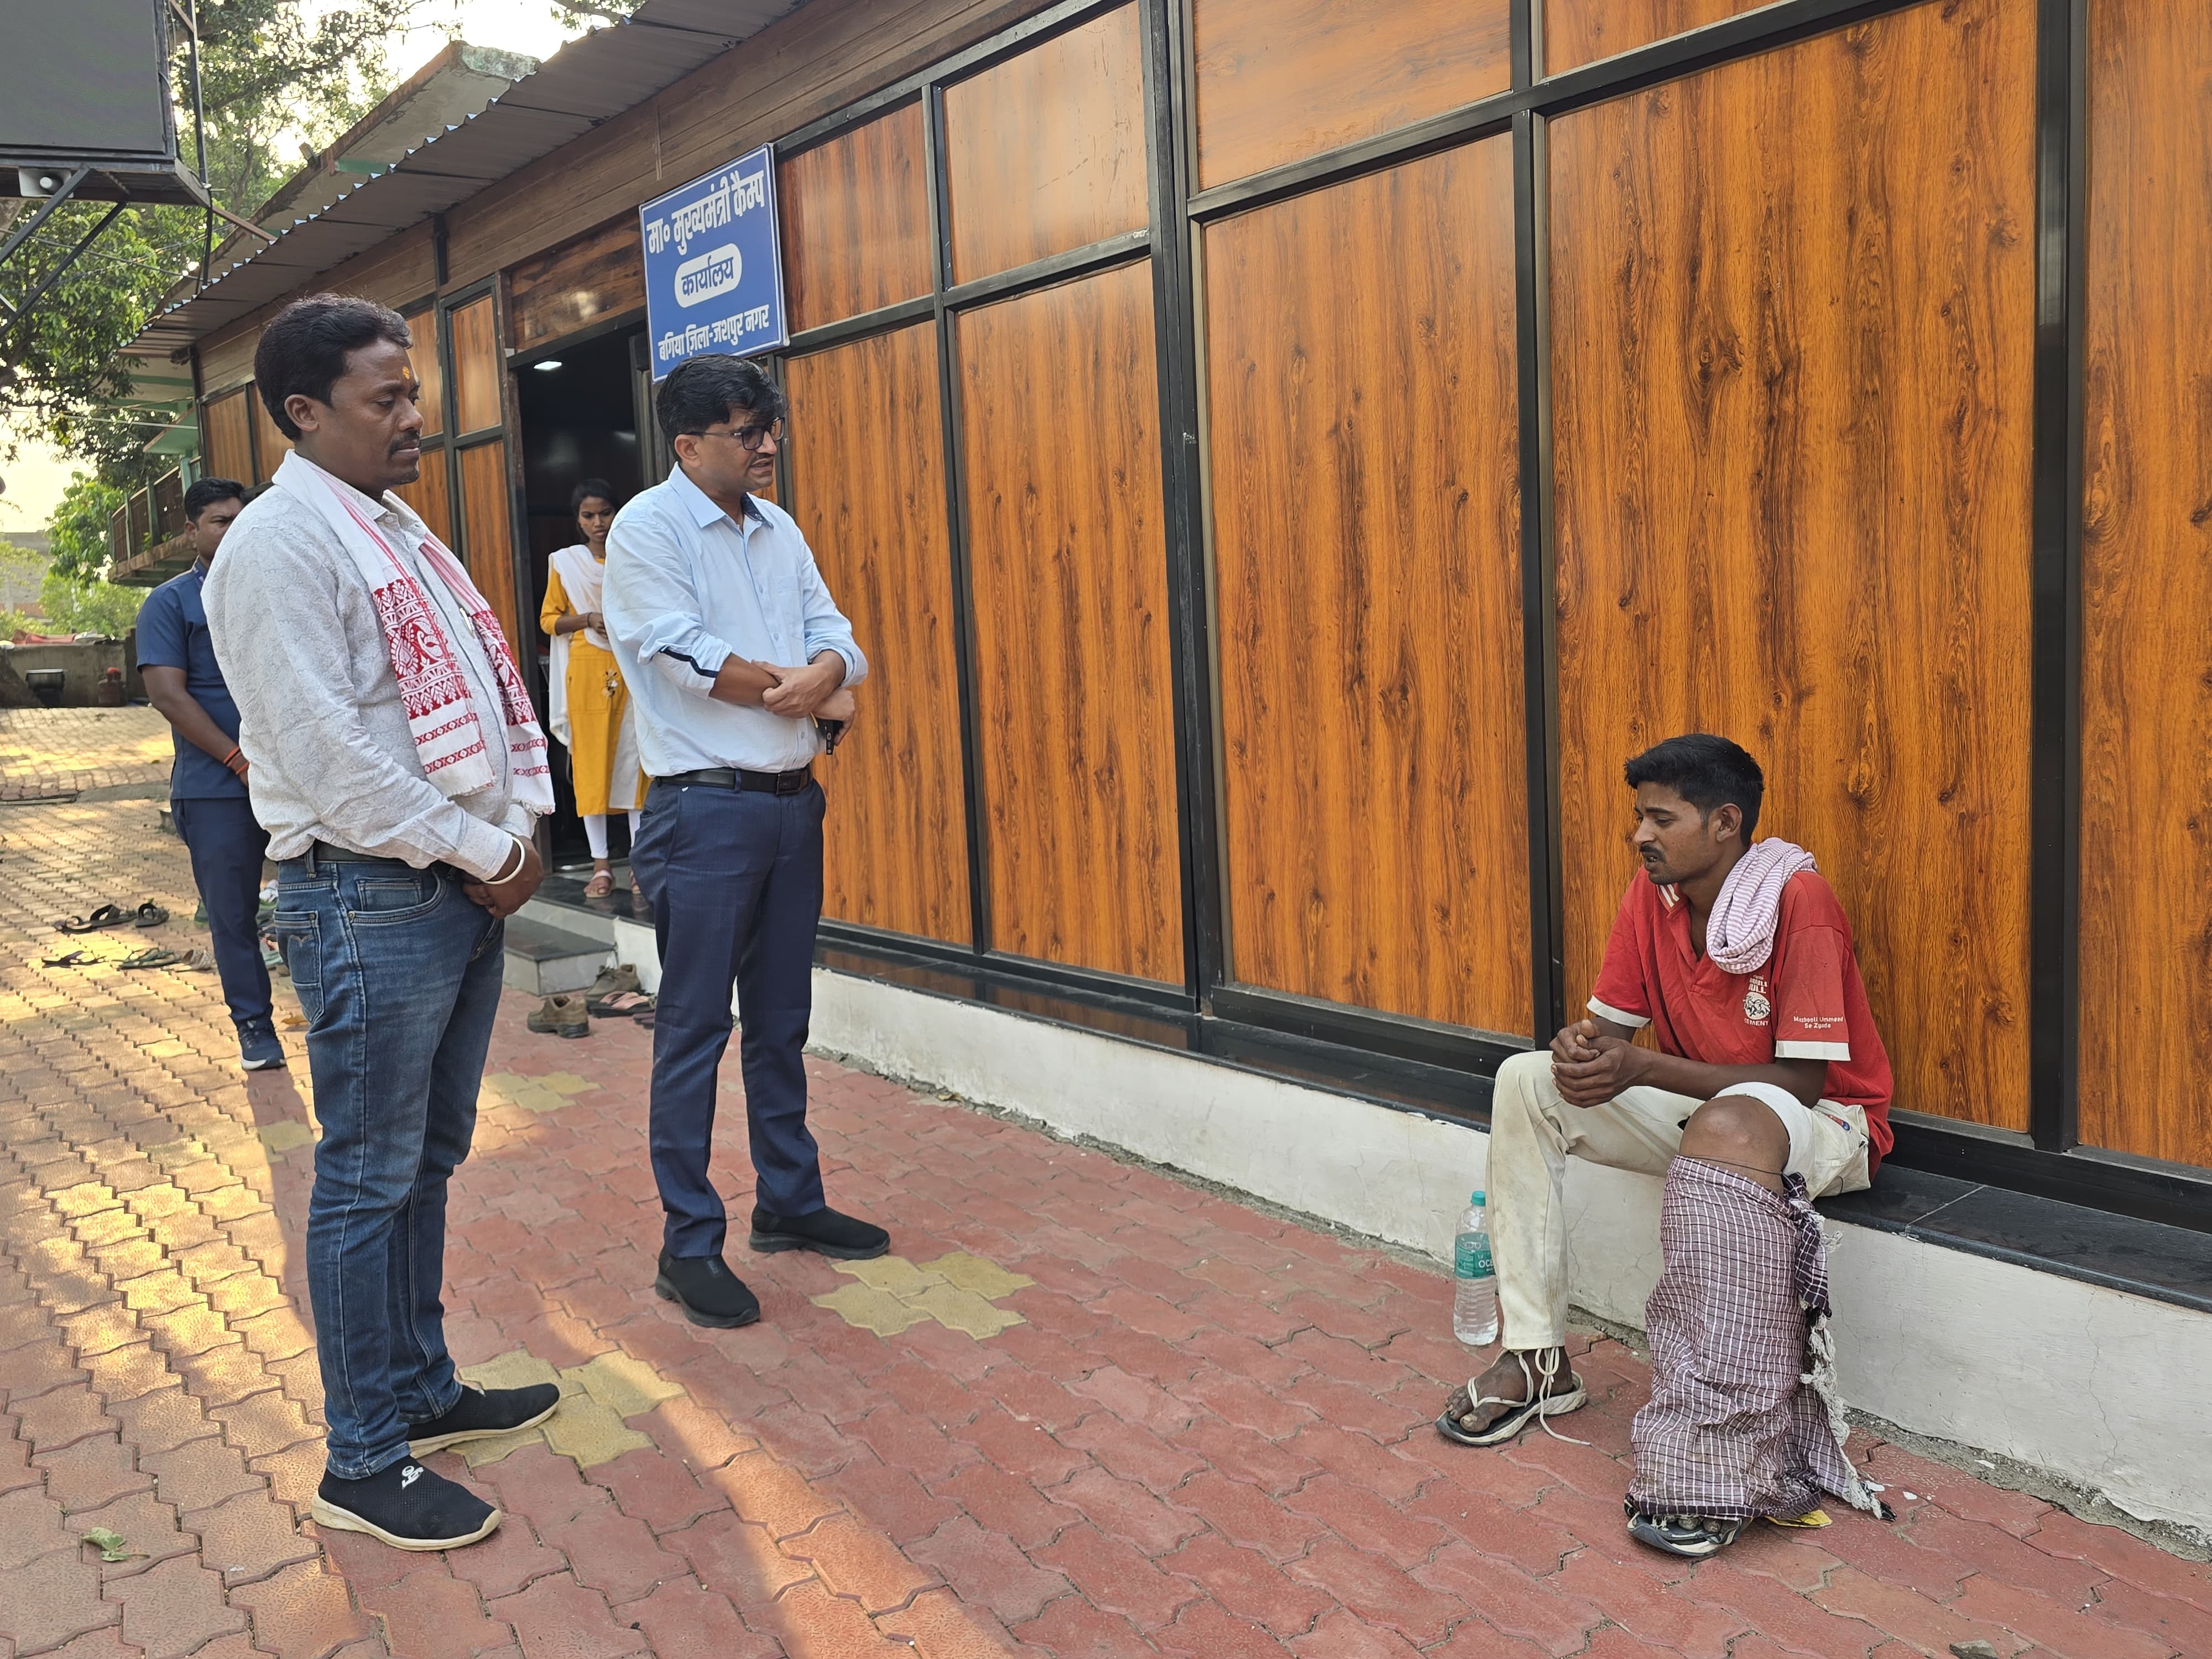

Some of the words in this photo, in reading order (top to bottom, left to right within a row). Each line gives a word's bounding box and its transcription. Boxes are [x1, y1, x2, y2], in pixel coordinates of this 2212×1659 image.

[671, 176, 731, 256] मुख्यमंत्री
[731, 169, 765, 217] कैम्प
[681, 255, 734, 296] कार्यालय
[658, 331, 685, 361] बगिया
[744, 304, 769, 332] नगर
[1744, 1018, 1769, 1026] CEMENT
